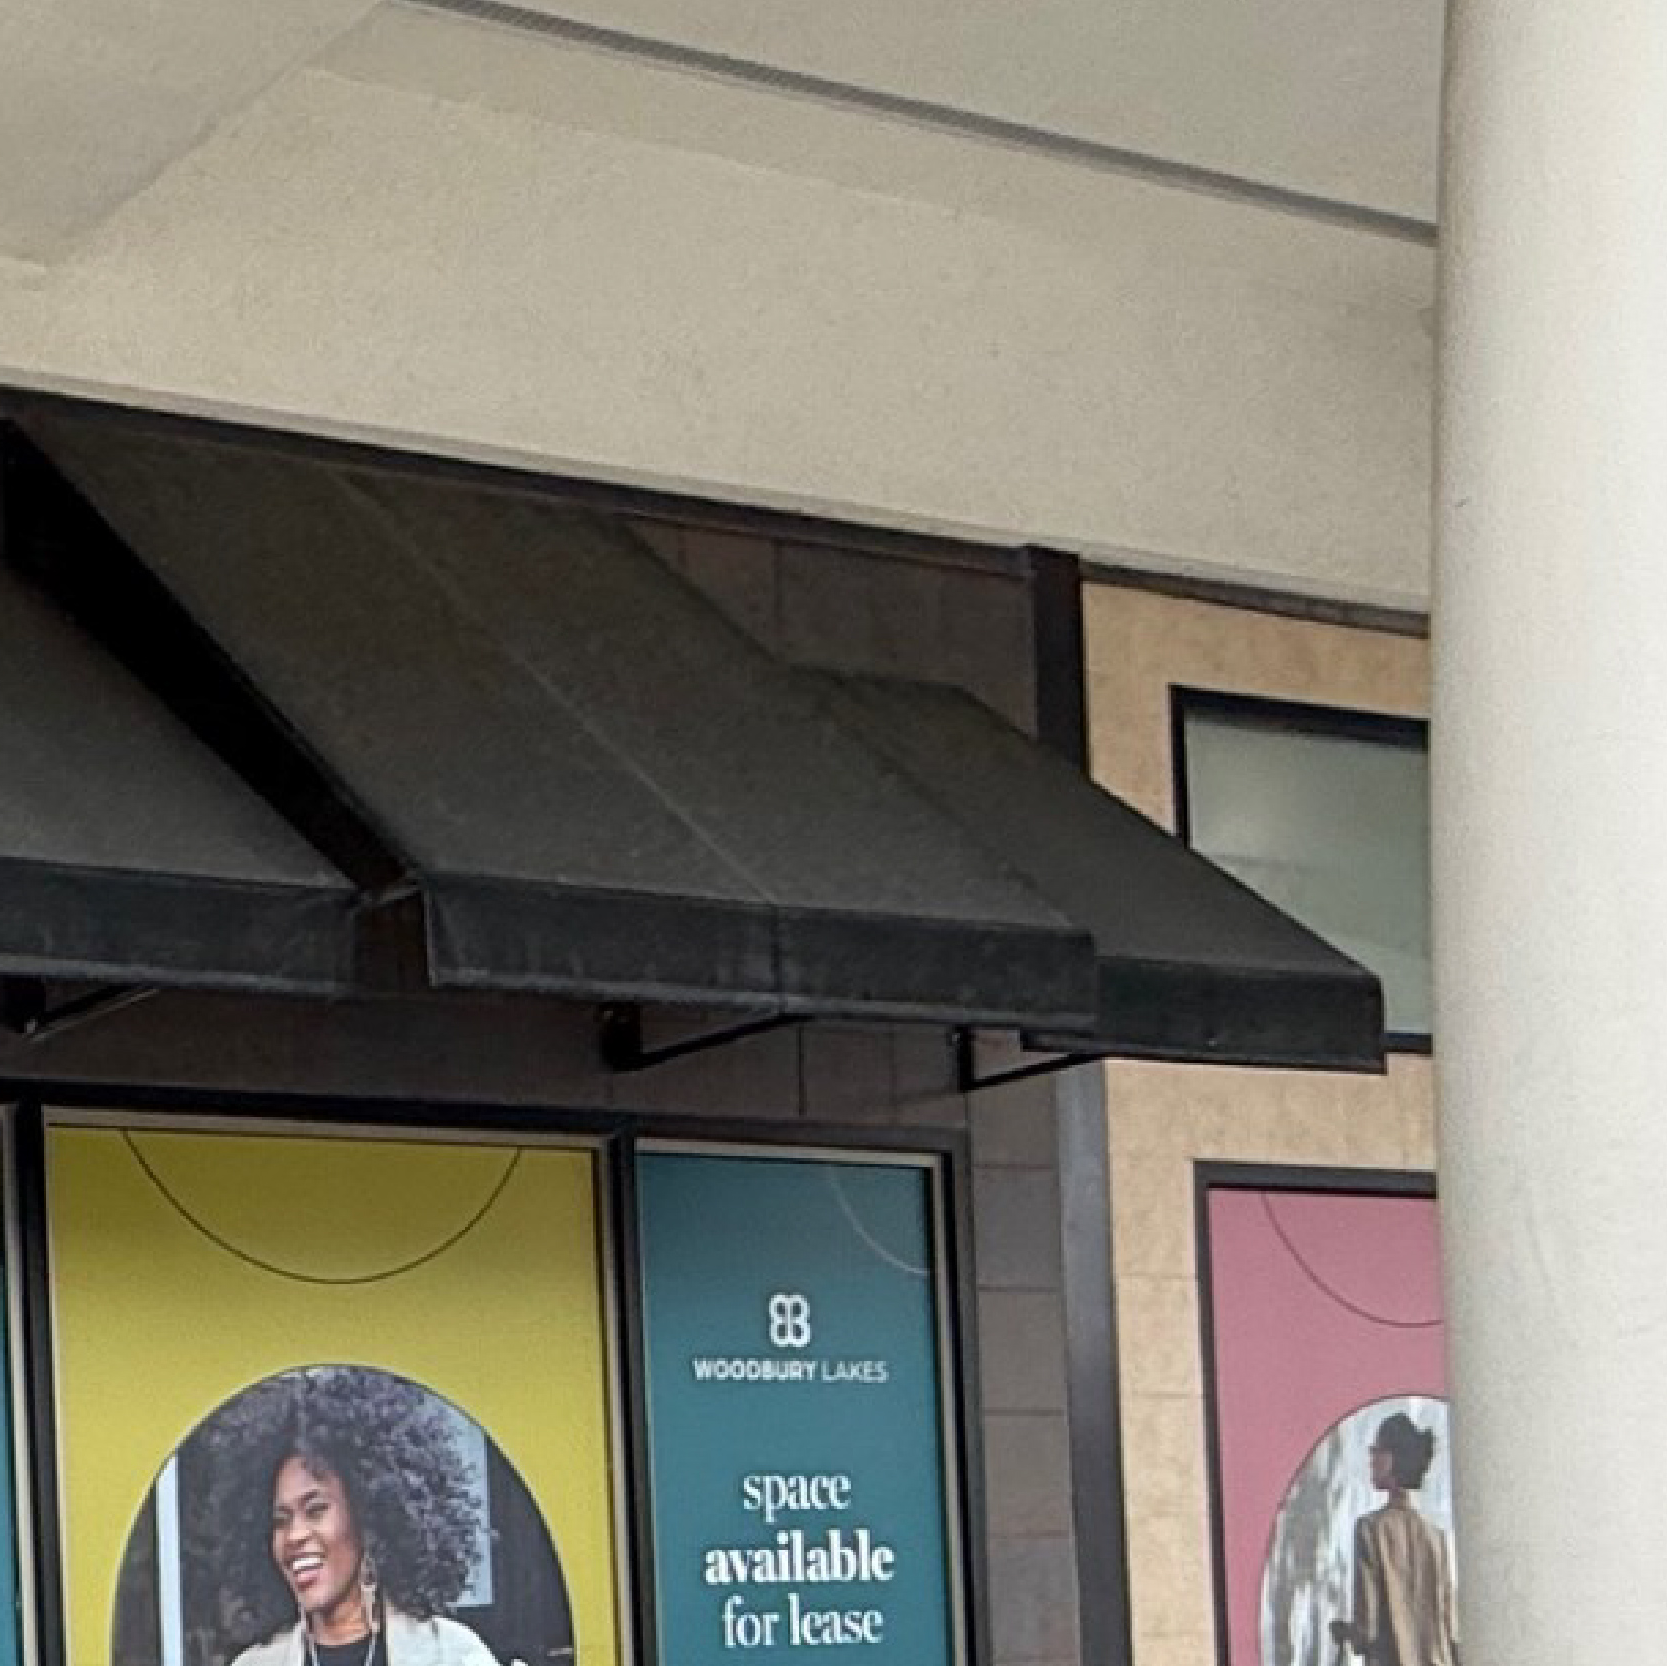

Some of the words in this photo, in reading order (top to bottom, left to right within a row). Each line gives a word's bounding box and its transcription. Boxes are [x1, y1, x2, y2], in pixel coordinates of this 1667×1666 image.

[744, 1475, 852, 1523] space
[705, 1529, 895, 1586] available
[722, 1595, 779, 1649] for
[788, 1592, 884, 1646] lease
